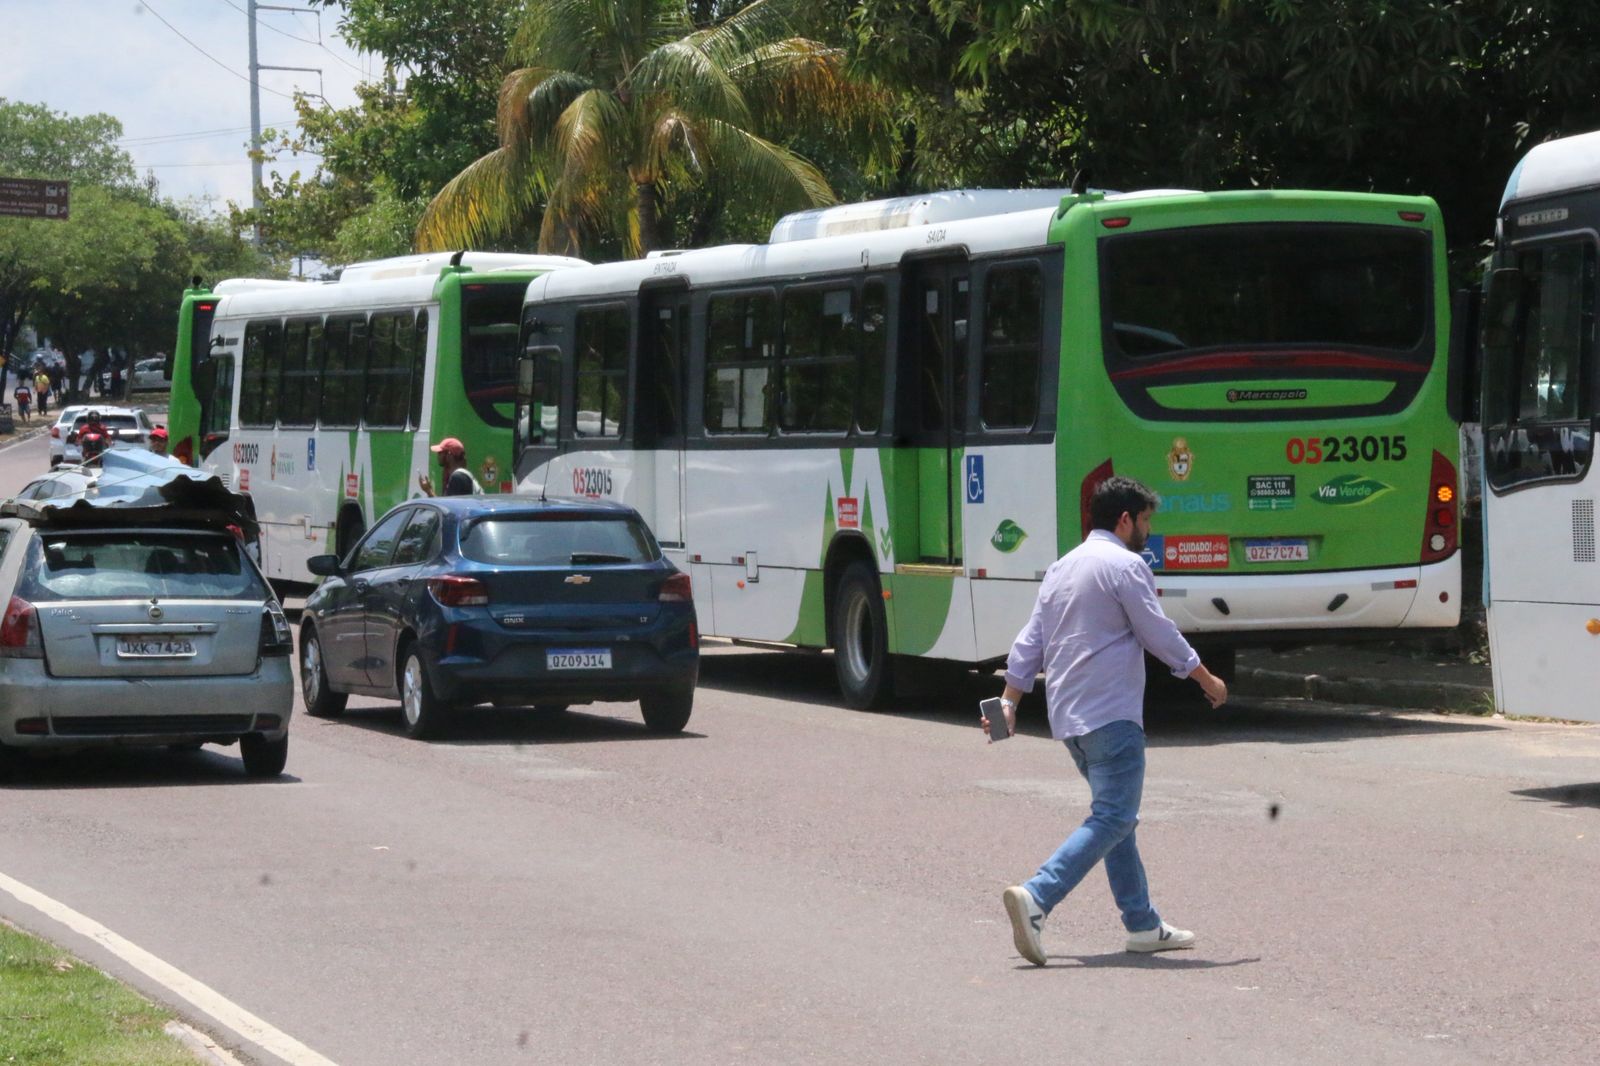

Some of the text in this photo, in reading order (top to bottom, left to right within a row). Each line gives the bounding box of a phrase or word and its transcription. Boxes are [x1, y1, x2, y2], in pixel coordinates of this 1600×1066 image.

[1239, 390, 1306, 400] Marcopolo
[1286, 435, 1408, 464] 0523015
[573, 467, 612, 495] 0523015
[1256, 481, 1286, 489] SAC 118
[1319, 484, 1372, 497] Via Verde
[1156, 493, 1232, 512] anaus
[1178, 541, 1212, 552] CUIDADO!
[1251, 546, 1302, 560] QZF7C74
[1179, 553, 1197, 563] PONTO
